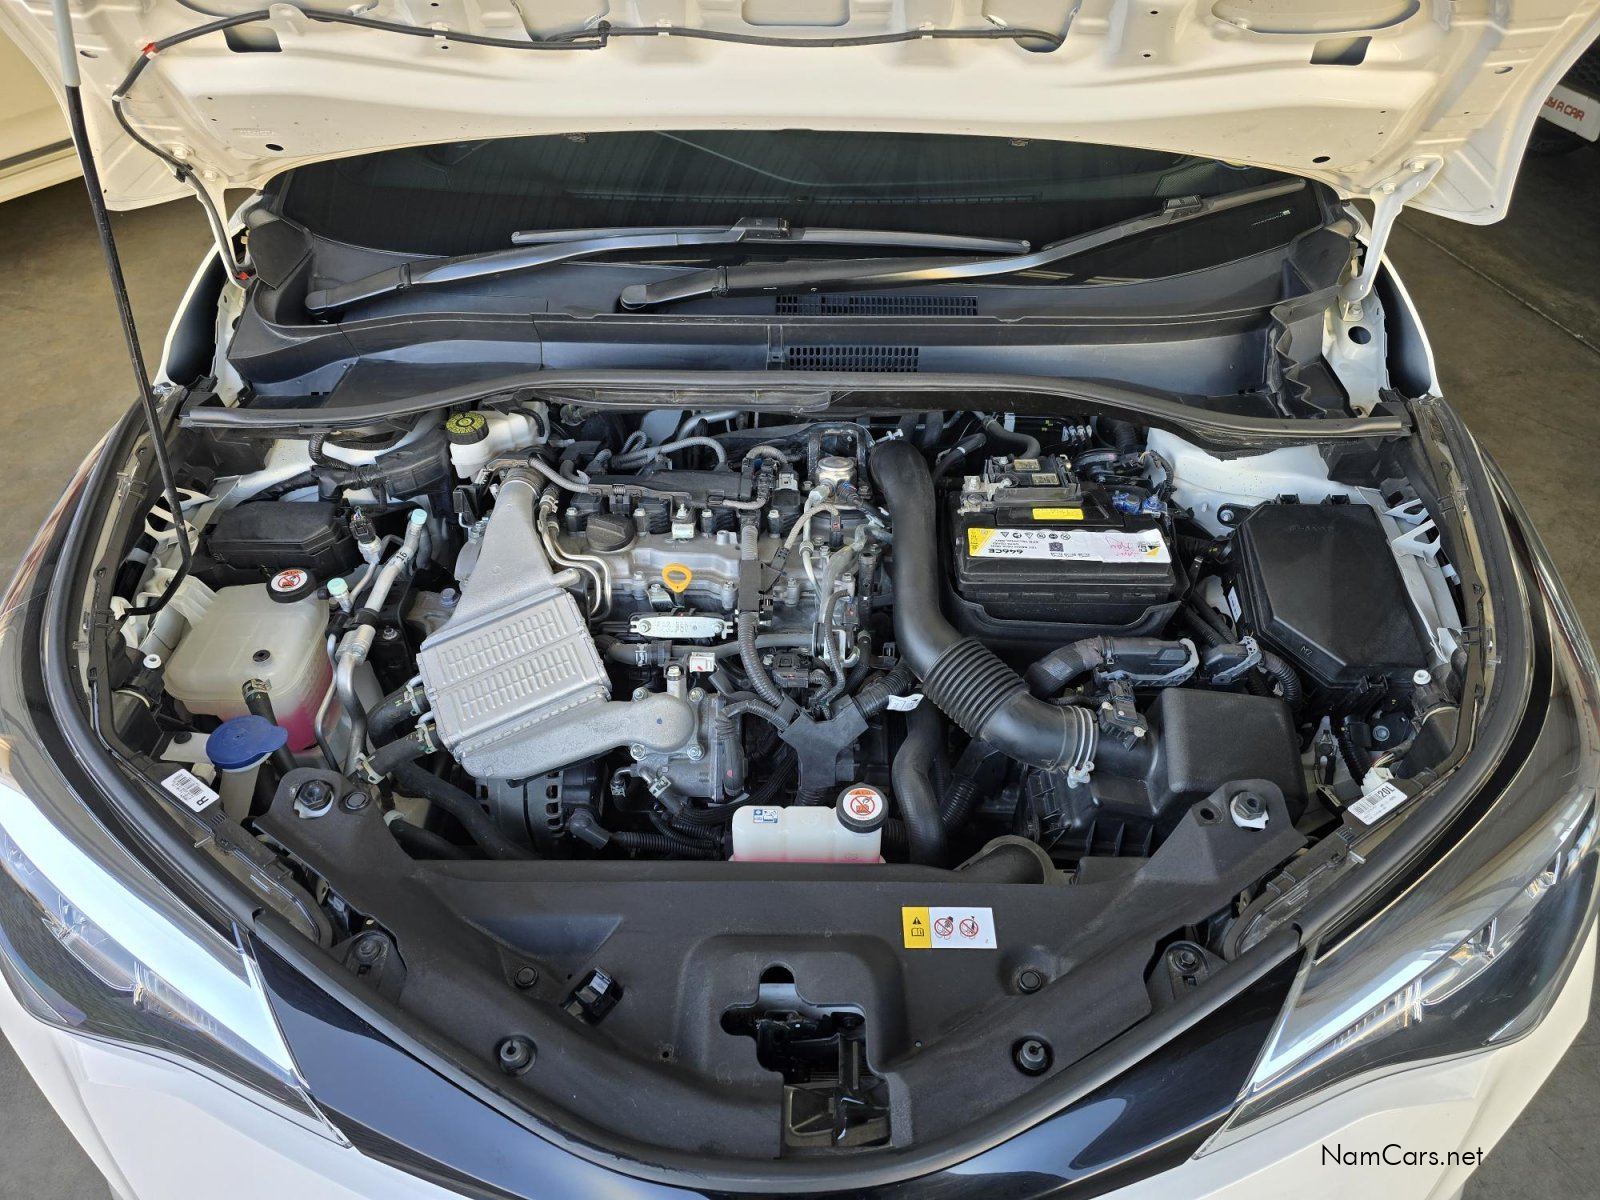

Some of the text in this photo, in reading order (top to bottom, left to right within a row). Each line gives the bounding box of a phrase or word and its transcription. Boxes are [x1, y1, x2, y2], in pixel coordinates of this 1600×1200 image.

[1563, 104, 1585, 121] CAR
[1377, 785, 1395, 798] 20L
[196, 795, 209, 806] R
